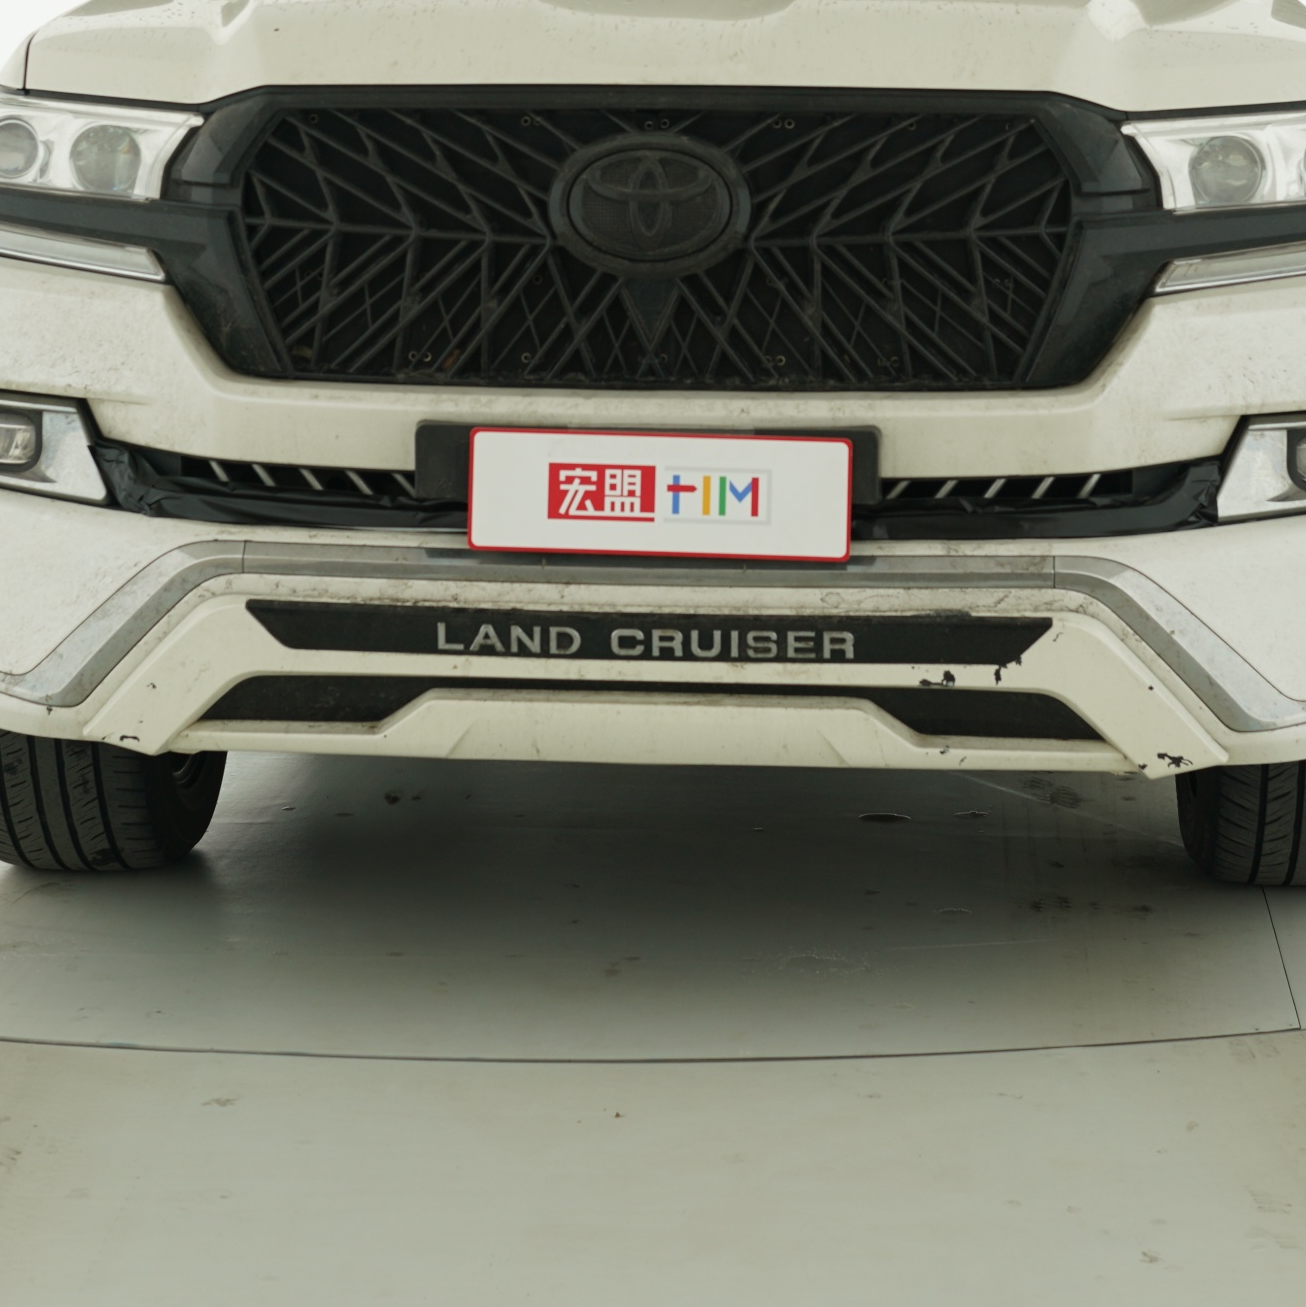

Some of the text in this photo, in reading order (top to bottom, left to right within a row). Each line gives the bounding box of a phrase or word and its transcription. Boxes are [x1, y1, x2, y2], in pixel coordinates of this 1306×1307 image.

[558, 467, 654, 518] 宏盟
[436, 621, 855, 660] LAND CRUISER
